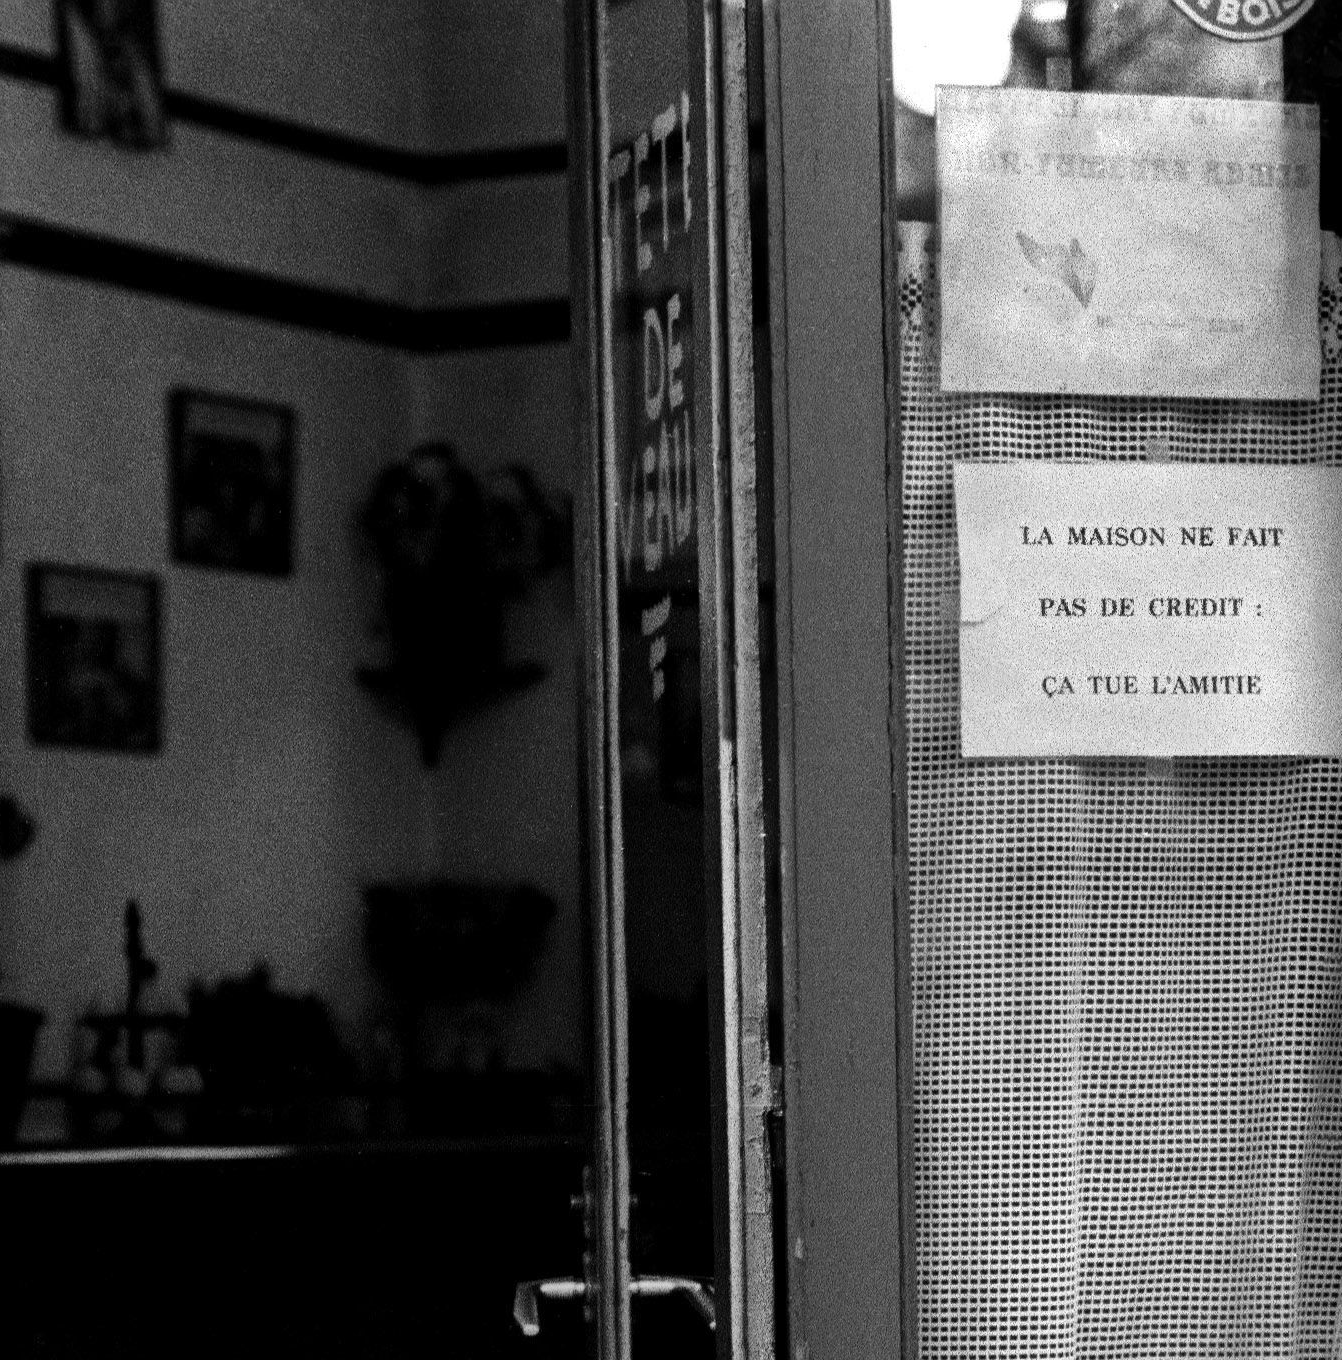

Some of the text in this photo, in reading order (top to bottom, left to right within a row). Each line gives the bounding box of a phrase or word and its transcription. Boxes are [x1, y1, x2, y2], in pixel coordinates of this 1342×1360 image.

[644, 292, 684, 420] DE
[616, 408, 691, 587] VEAU
[1021, 525, 1285, 547] LA MAISON NE FAIT
[1039, 597, 1087, 618] PAS
[1101, 597, 1134, 617] DE
[1148, 596, 1244, 617] CREDIT
[1042, 674, 1262, 698] ÇA TUE L'AMITIE
